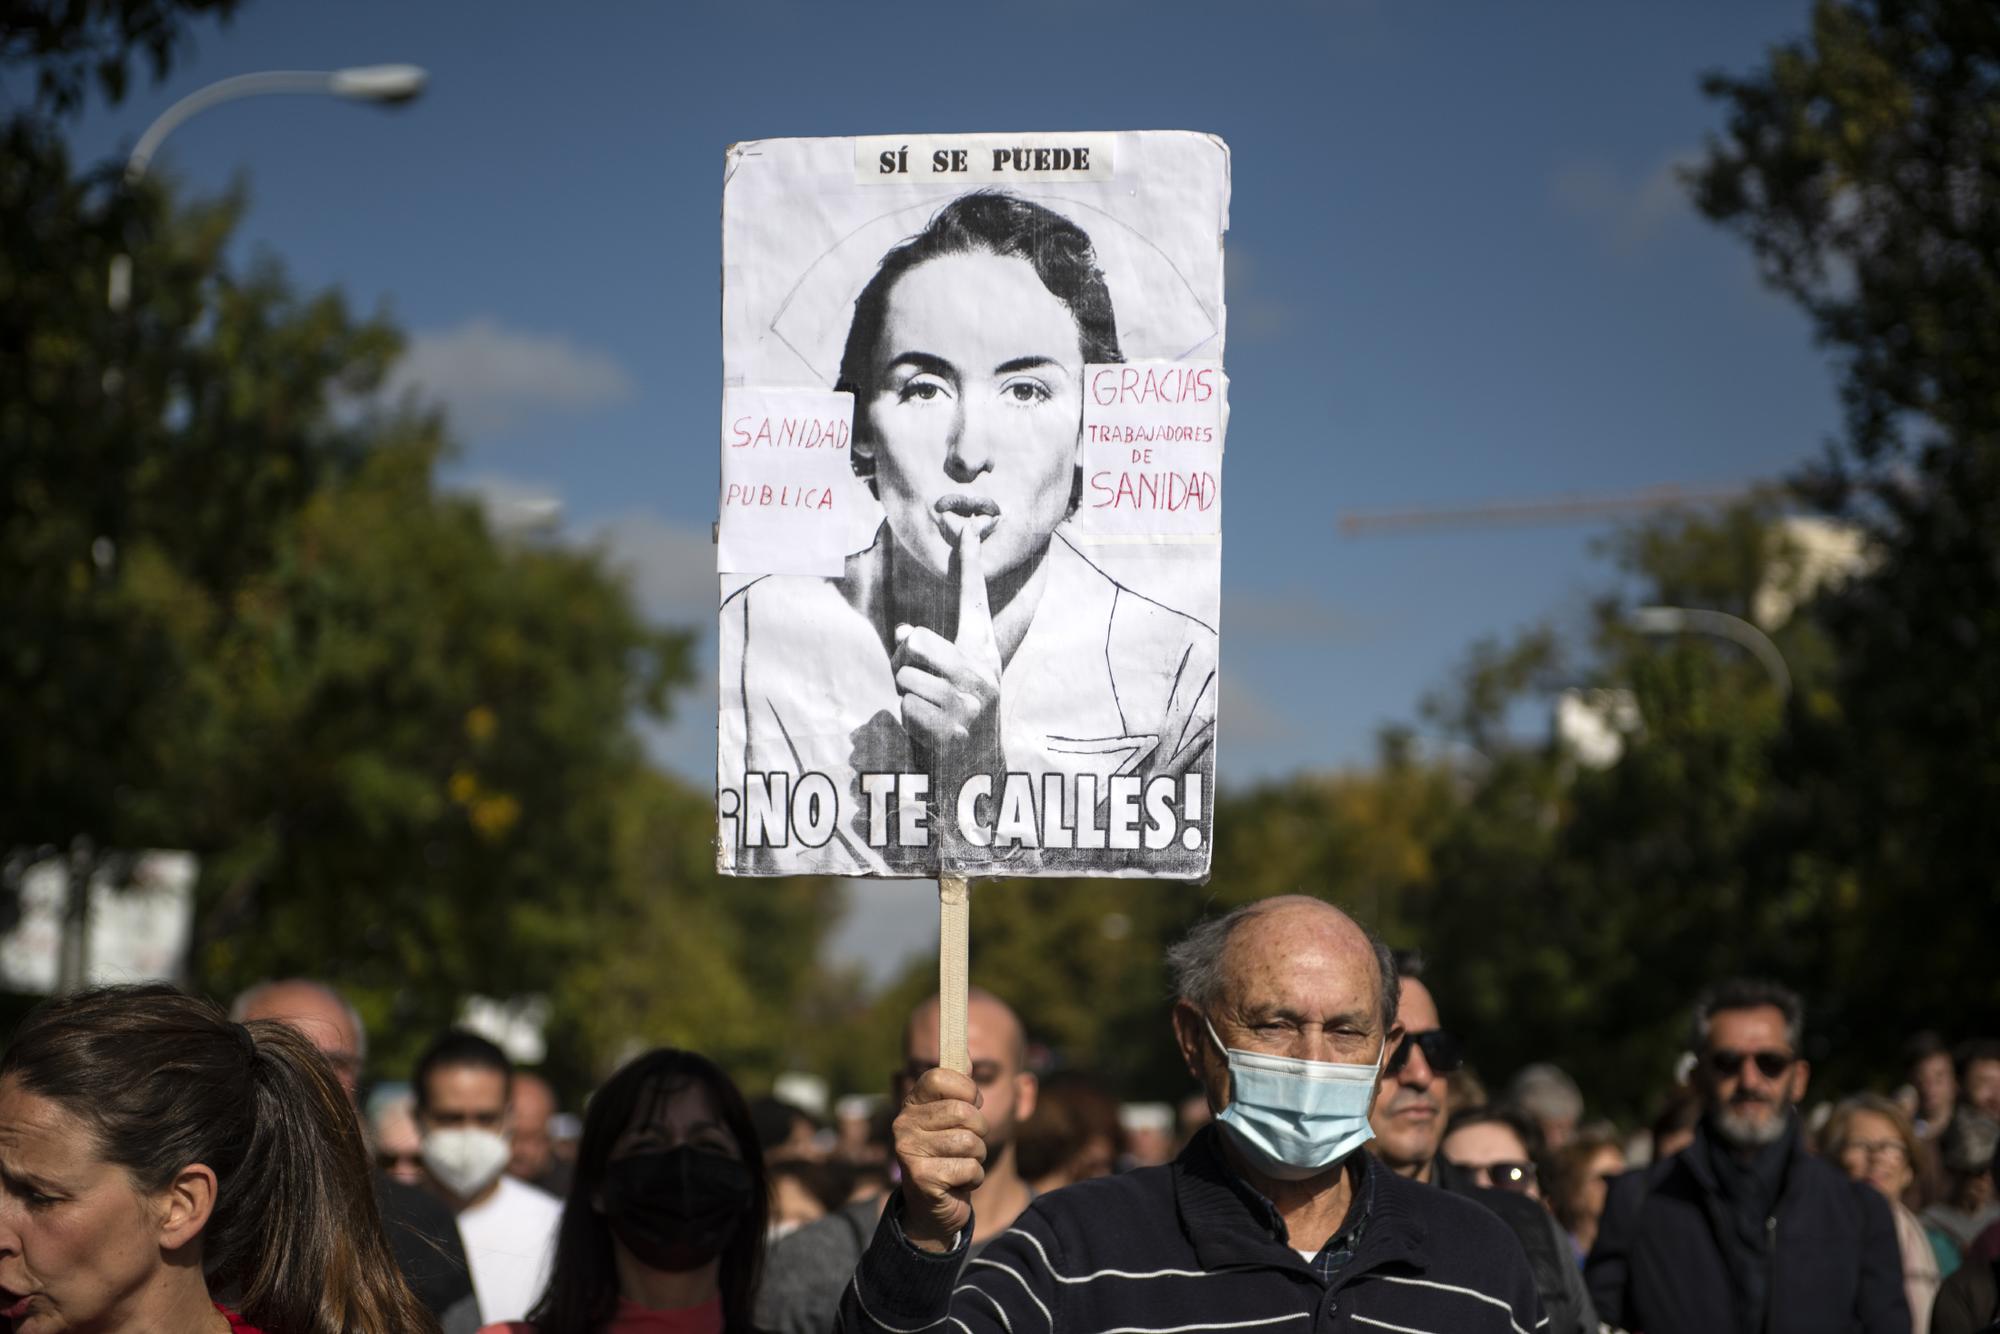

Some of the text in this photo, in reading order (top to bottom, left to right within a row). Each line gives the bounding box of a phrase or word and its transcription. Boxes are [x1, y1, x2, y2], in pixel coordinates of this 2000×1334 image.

[879, 145, 1090, 174] SÍ SE PUEDE
[1092, 368, 1213, 406] GRACIAS
[731, 416, 849, 449] SANIDAD
[1088, 425, 1213, 443] TRABAJADORES
[1131, 448, 1153, 464] DE
[726, 483, 833, 510] PUBLICA
[1091, 471, 1216, 512] SANIDAD
[860, 771, 930, 848] TE
[956, 771, 1203, 850] CALLES!
